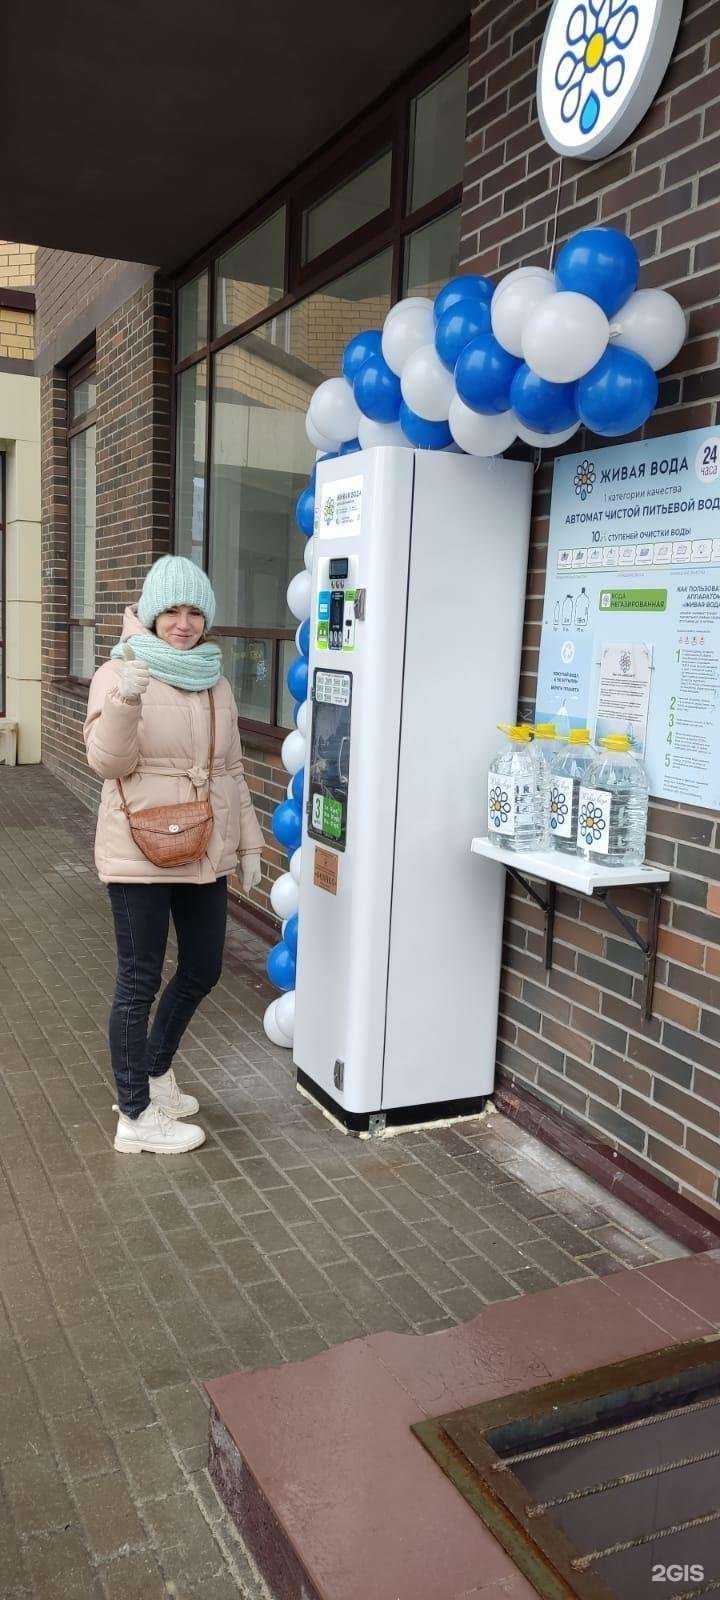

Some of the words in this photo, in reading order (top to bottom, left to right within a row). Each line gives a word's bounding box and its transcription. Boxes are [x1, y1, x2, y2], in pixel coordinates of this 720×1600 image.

[703, 445, 717, 464] 24
[600, 464, 645, 483] ЖИВАЯ
[650, 457, 689, 475] ВОДА
[701, 465, 717, 476] часа
[608, 490, 646, 503] категории
[647, 485, 682, 497] качества
[565, 511, 603, 525] АВТОМАТ
[604, 505, 640, 520] ЧИСТОЙ
[642, 499, 695, 516] ПИТЬЕВОЙ
[608, 530, 639, 542] СТУПЕНЕЙ
[639, 528, 669, 540] ОЧИСТКИ
[670, 527, 691, 537] ВОДЫ
[675, 649, 681, 663] 1
[670, 696, 676, 711] 2
[668, 713, 674, 727] 3
[666, 732, 672, 745] 4
[664, 753, 671, 768] 5
